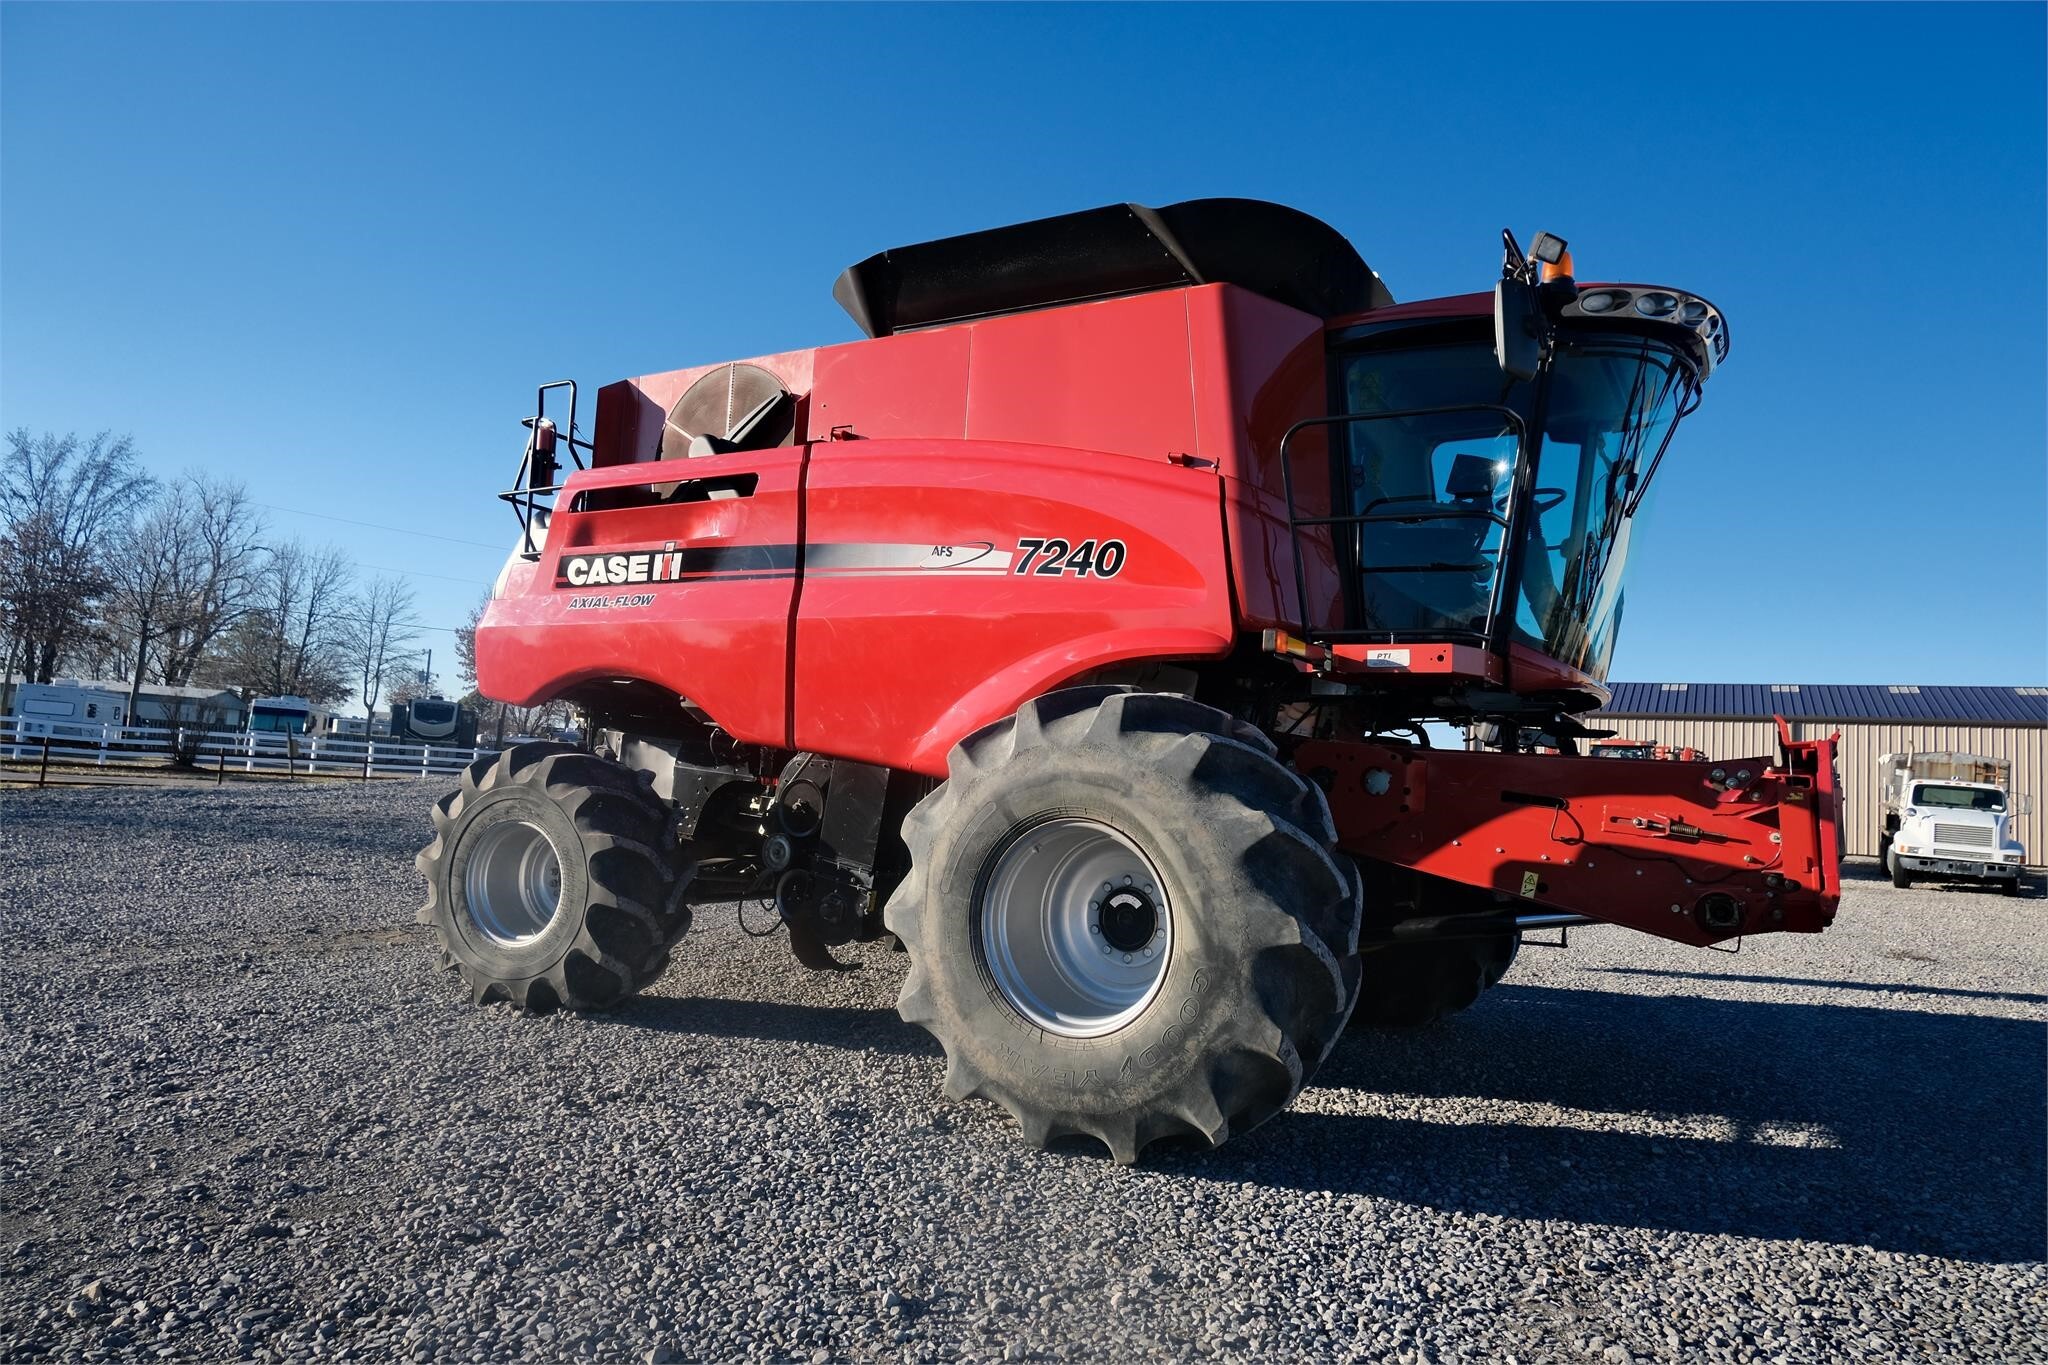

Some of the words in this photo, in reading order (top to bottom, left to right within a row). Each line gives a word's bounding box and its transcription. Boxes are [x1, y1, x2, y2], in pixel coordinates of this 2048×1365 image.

[931, 545, 953, 558] AFS
[1014, 537, 1127, 580] 7240
[567, 554, 650, 586] CASE
[569, 594, 656, 610] AXIAL-FLOW
[1376, 652, 1392, 660] PTI
